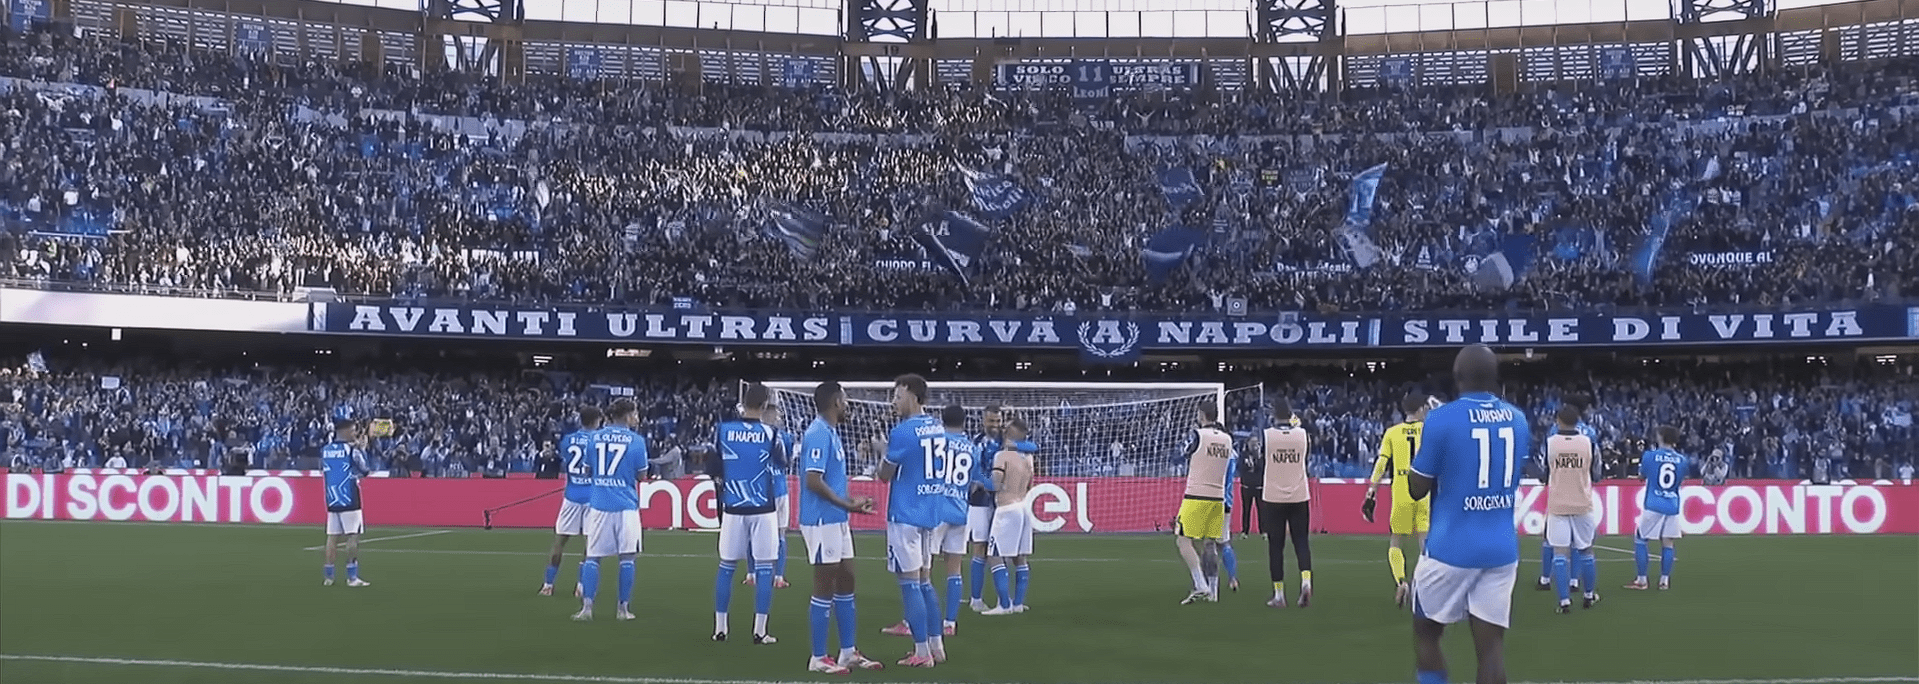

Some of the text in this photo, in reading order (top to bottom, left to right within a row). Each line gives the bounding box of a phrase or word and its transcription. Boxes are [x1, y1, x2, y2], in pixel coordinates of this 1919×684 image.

[1016, 65, 1064, 74] SOLO
[1690, 251, 1773, 265] OVUNQUE AL
[350, 306, 828, 340] AVANTI ULTRAS
[867, 320, 1359, 344] CURVA A NAPOLI
[1404, 311, 1863, 343] STILE DI VITA
[594, 442, 627, 476] 17
[920, 437, 947, 480] 13
[945, 450, 973, 487] 18
[1406, 436, 1416, 467] 1
[1471, 427, 1514, 489] 11
[1555, 457, 1583, 469] NAPOLI
[1659, 463, 1676, 489] 6
[7, 473, 294, 523] DI SCONTO
[639, 480, 722, 529] ne
[1026, 482, 1094, 533] el
